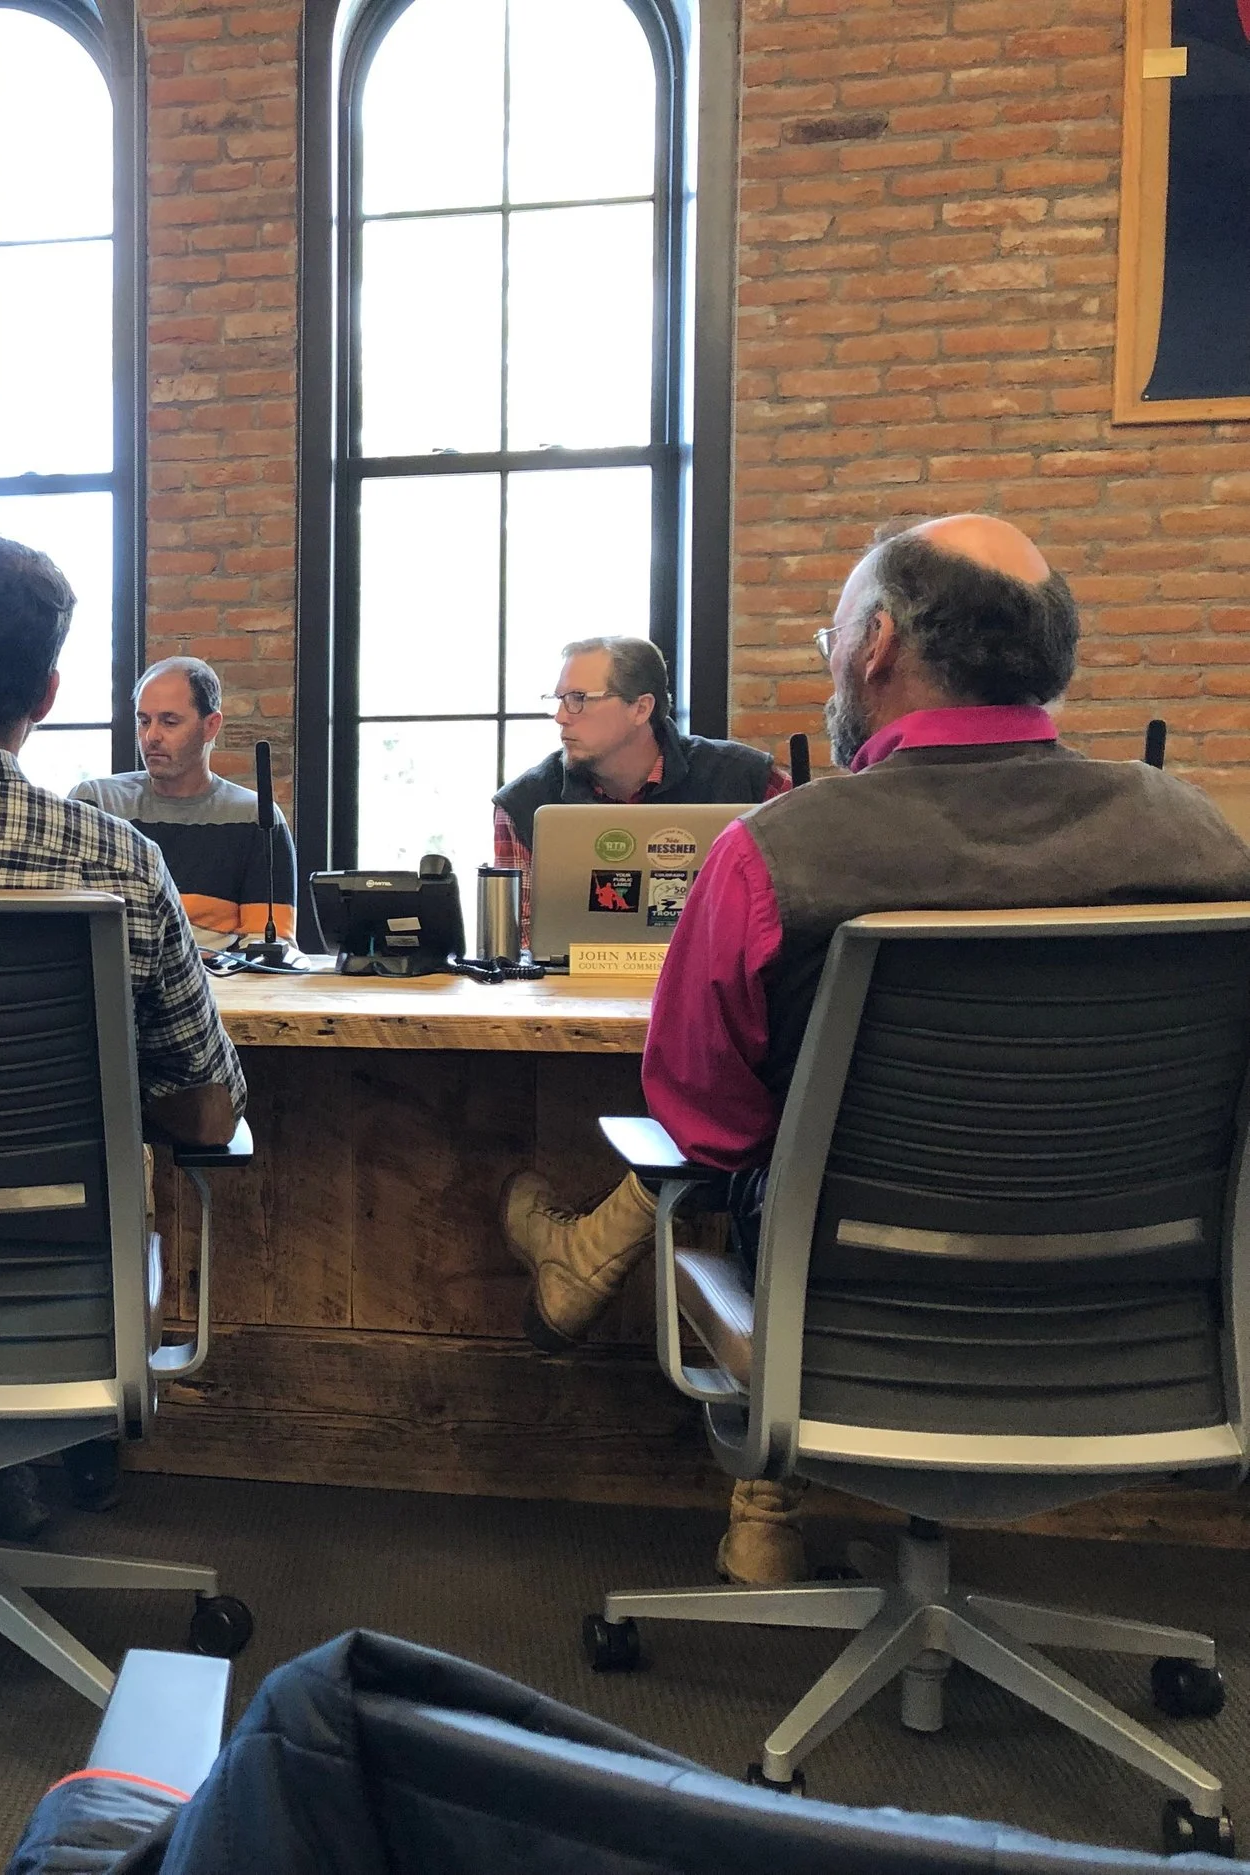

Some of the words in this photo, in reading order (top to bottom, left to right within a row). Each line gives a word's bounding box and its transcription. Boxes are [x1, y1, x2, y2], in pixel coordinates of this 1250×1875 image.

[647, 844, 696, 854] MESSNER
[578, 951, 619, 961] JOHN
[578, 962, 619, 970] COUNTY
